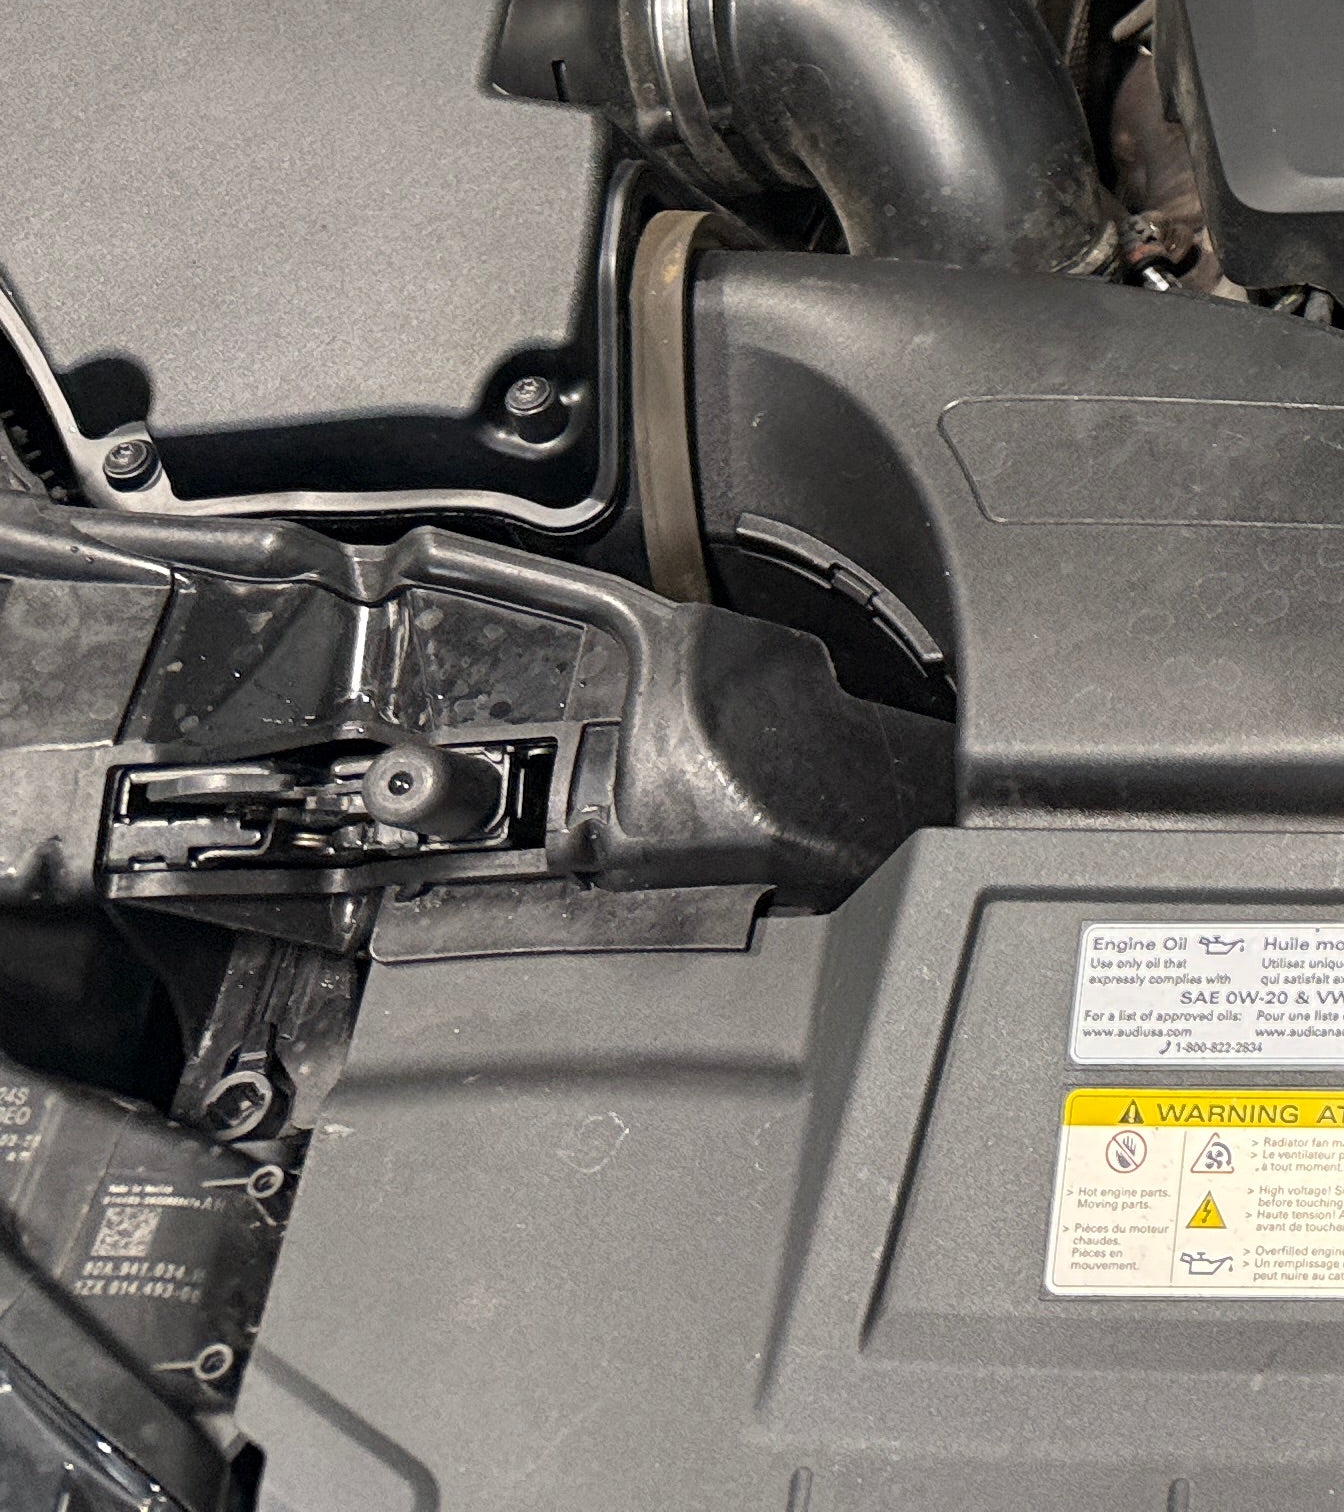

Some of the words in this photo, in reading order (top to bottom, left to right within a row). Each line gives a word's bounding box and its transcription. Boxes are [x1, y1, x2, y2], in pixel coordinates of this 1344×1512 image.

[1092, 936, 1157, 954] Engine
[1163, 936, 1189, 951] Oil
[1263, 937, 1310, 952] Huile
[1089, 957, 1113, 970] Use
[1116, 957, 1143, 972] only
[1145, 957, 1161, 970] oil
[1163, 957, 1188, 970] that
[1261, 957, 1306, 970] Utilisez
[1088, 974, 1146, 987] expressly
[1148, 973, 1203, 986] complies
[1205, 973, 1232, 985] with
[1260, 973, 1281, 986] qui
[1283, 973, 1331, 985] satisfait
[1179, 990, 1221, 1005] SAE
[1225, 990, 1289, 1005] 0W-20
[1295, 990, 1310, 1005] &
[1083, 1009, 1106, 1022] For
[1107, 1012, 1116, 1022] a
[1118, 1009, 1137, 1022] list
[1139, 1009, 1154, 1022] of
[1155, 1010, 1214, 1024] approved
[1216, 1009, 1243, 1022] oils:
[1255, 1009, 1285, 1022] Pour
[1288, 1012, 1312, 1022] une
[1314, 1009, 1340, 1022] liste
[1082, 1026, 1193, 1038] www.audiusa.com
[1175, 1041, 1263, 1054] 1-800-822-2834
[1156, 1103, 1299, 1124] WARNING
[1263, 1138, 1309, 1148] Radiator
[1311, 1139, 1330, 1149] fan
[1262, 1150, 1276, 1160] Le
[1277, 1150, 1335, 1160] ventilateur
[1270, 1162, 1293, 1172] tout
[1077, 1186, 1098, 1197] Hot
[1099, 1187, 1138, 1199] engine
[1140, 1188, 1172, 1199] parts.
[1259, 1185, 1285, 1198] High
[1287, 1186, 1331, 1198] voltage!
[1077, 1199, 1119, 1211] Moving
[1121, 1200, 1152, 1211] parts.
[1257, 1198, 1294, 1208] before
[1295, 1198, 1344, 1211] touching
[1256, 1210, 1289, 1220] Haute
[1291, 1210, 1337, 1220] tension!
[1111, 1223, 1126, 1234] du
[1128, 1224, 1170, 1234] moteur
[1255, 1223, 1286, 1232] avant
[1288, 1222, 1302, 1232] de
[1072, 1235, 1121, 1246] chaudes.
[1109, 1249, 1124, 1258] en
[1254, 1246, 1309, 1257] Overfilled
[1070, 1261, 1140, 1271] mouvement.
[1254, 1259, 1271, 1269] Un
[1273, 1258, 1340, 1270] remplissage
[1253, 1272, 1278, 1282] peut
[1280, 1271, 1309, 1281] nuire
[1311, 1272, 1326, 1281] au
